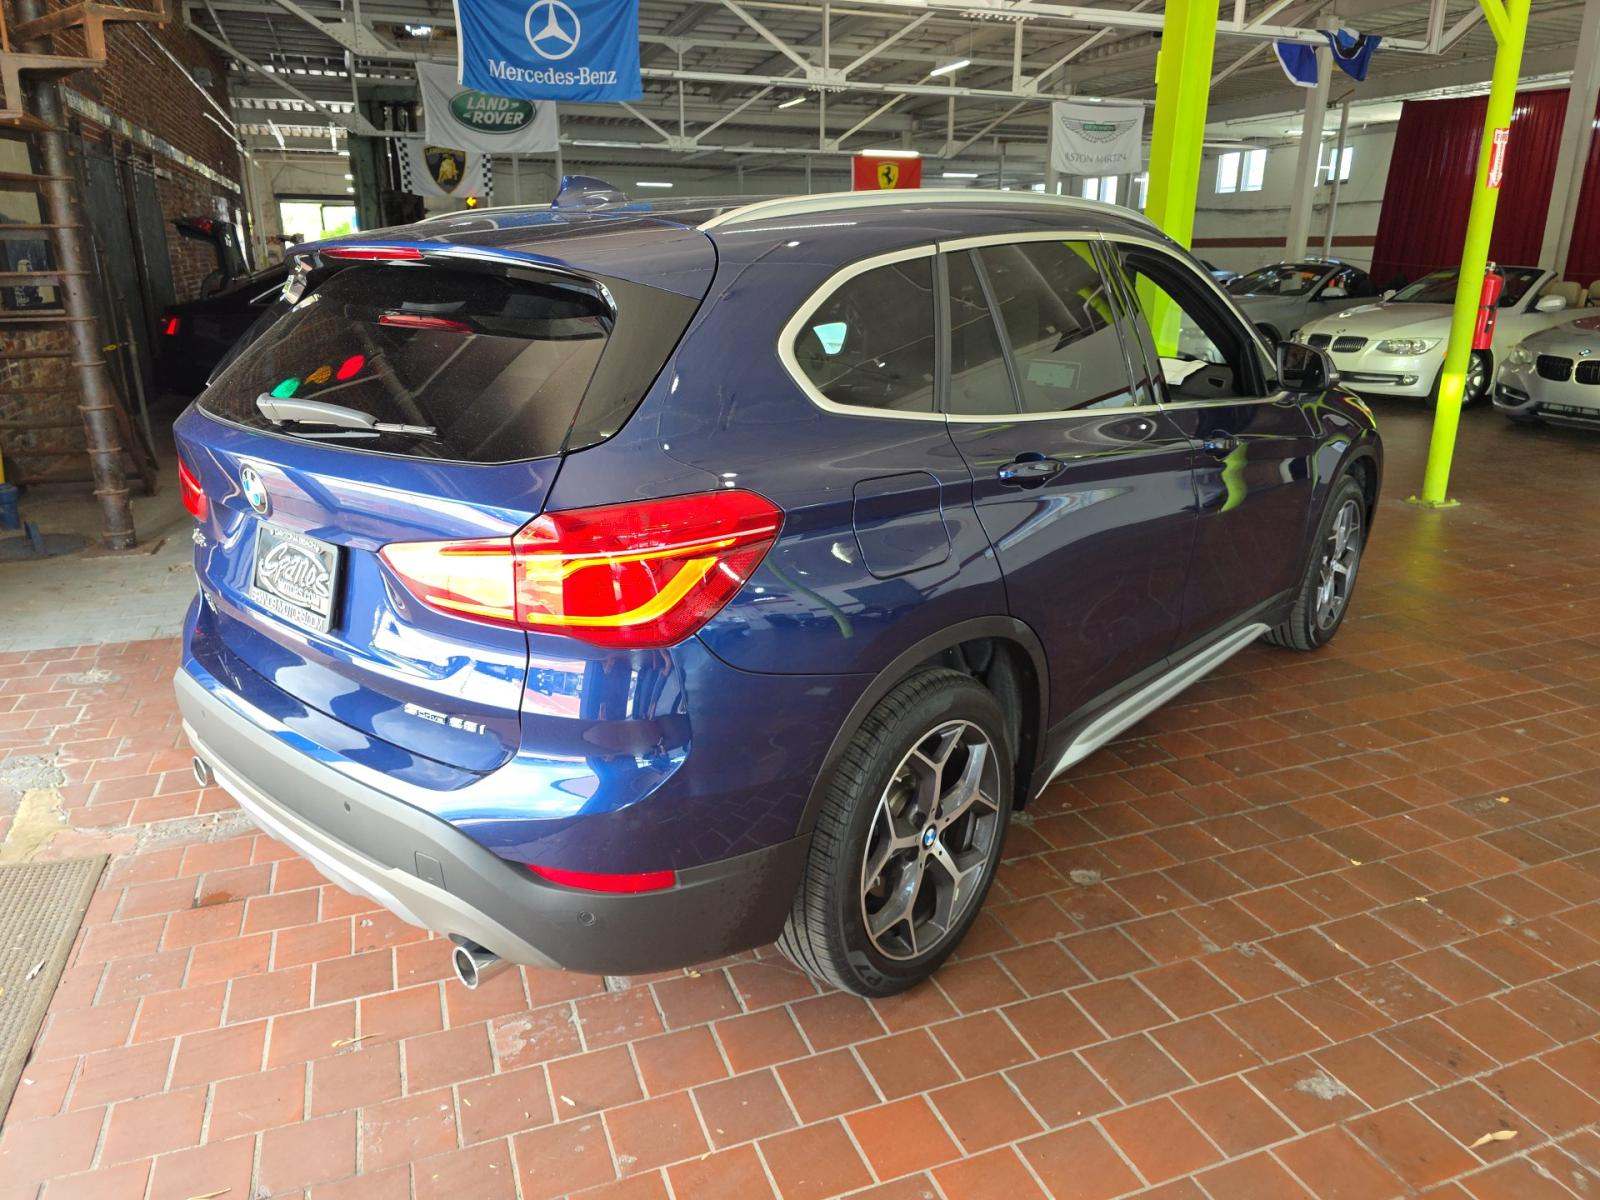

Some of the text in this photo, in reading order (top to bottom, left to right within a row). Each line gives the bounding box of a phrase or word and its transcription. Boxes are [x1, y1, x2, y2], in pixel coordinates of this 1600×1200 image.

[488, 59, 617, 85] Mercedes-Benz
[466, 96, 510, 109] LAND
[472, 110, 525, 125] ROVER
